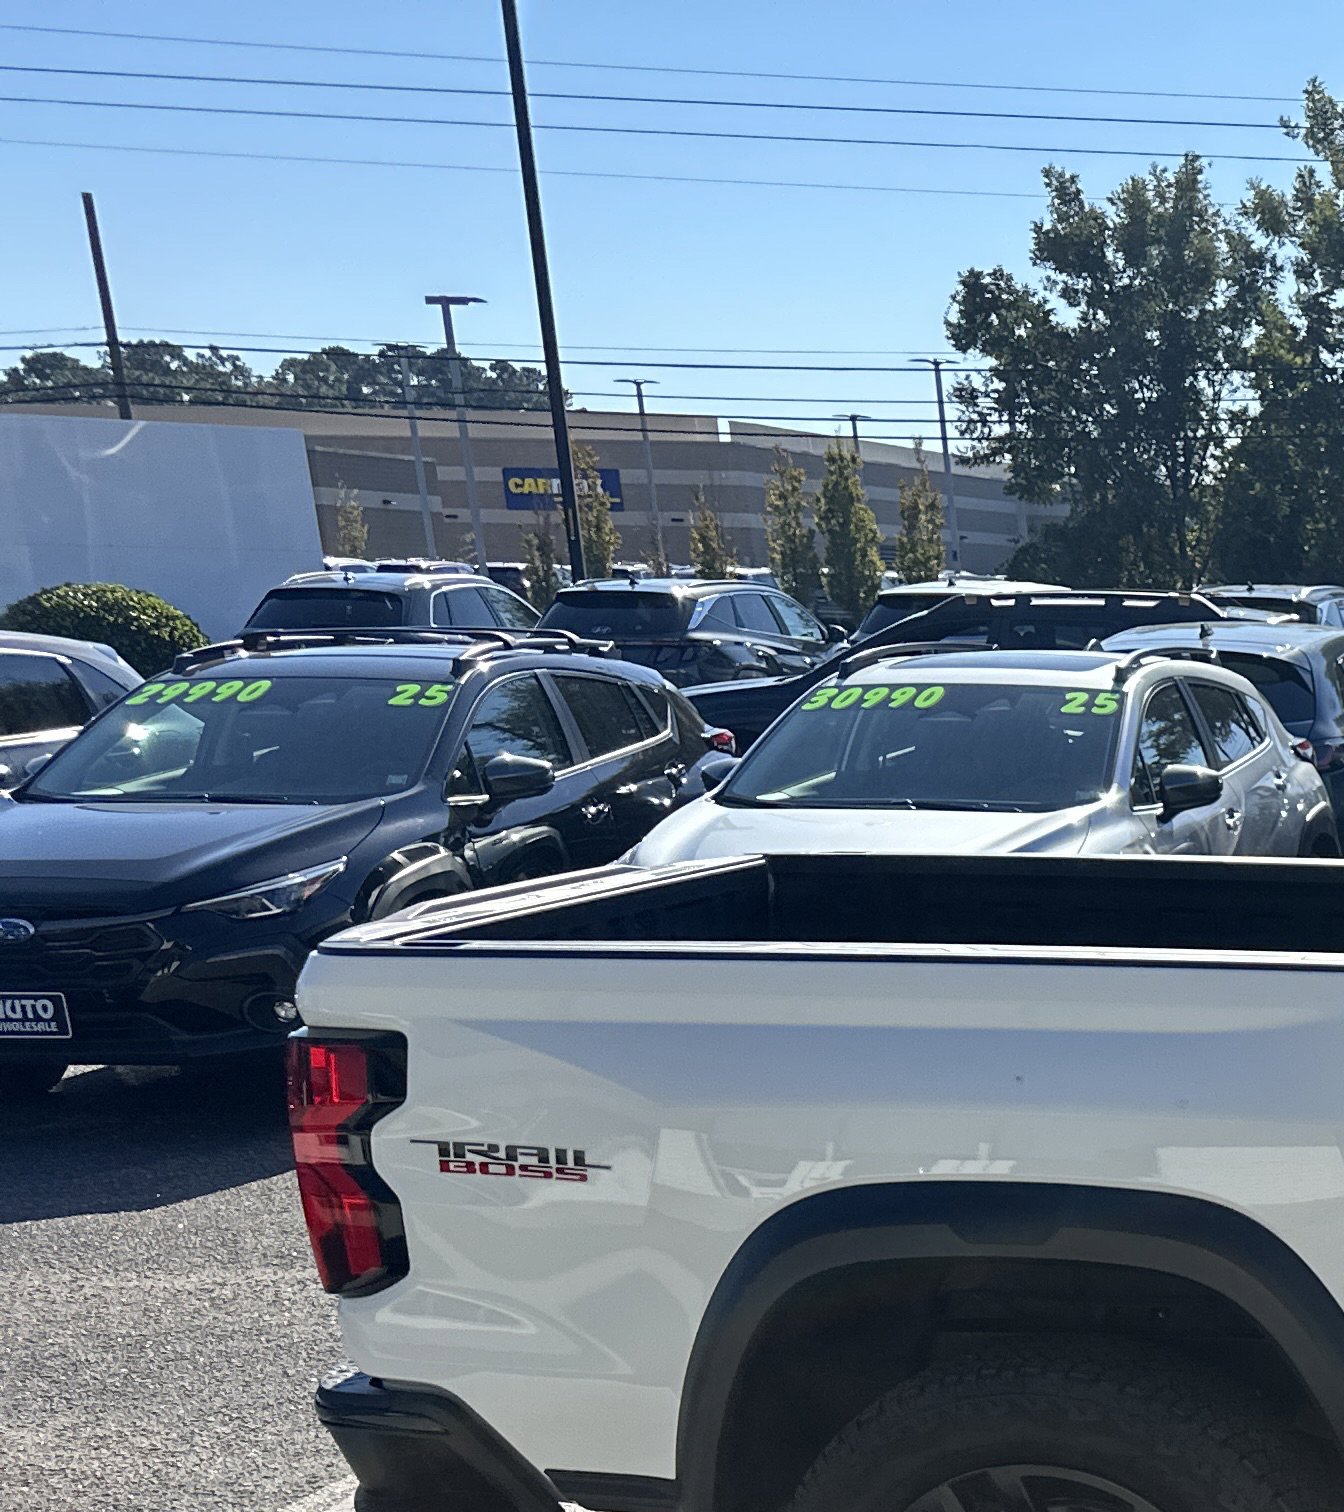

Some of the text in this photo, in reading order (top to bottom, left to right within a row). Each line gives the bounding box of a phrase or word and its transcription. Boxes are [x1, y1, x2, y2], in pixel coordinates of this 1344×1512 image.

[127, 680, 272, 706] 29990
[388, 683, 451, 708] 25
[801, 686, 944, 711] 30990
[1061, 691, 1119, 715] 25
[0, 999, 55, 1019] UTO
[410, 1138, 612, 1170] TRAIL
[438, 1159, 588, 1183] BOSS
